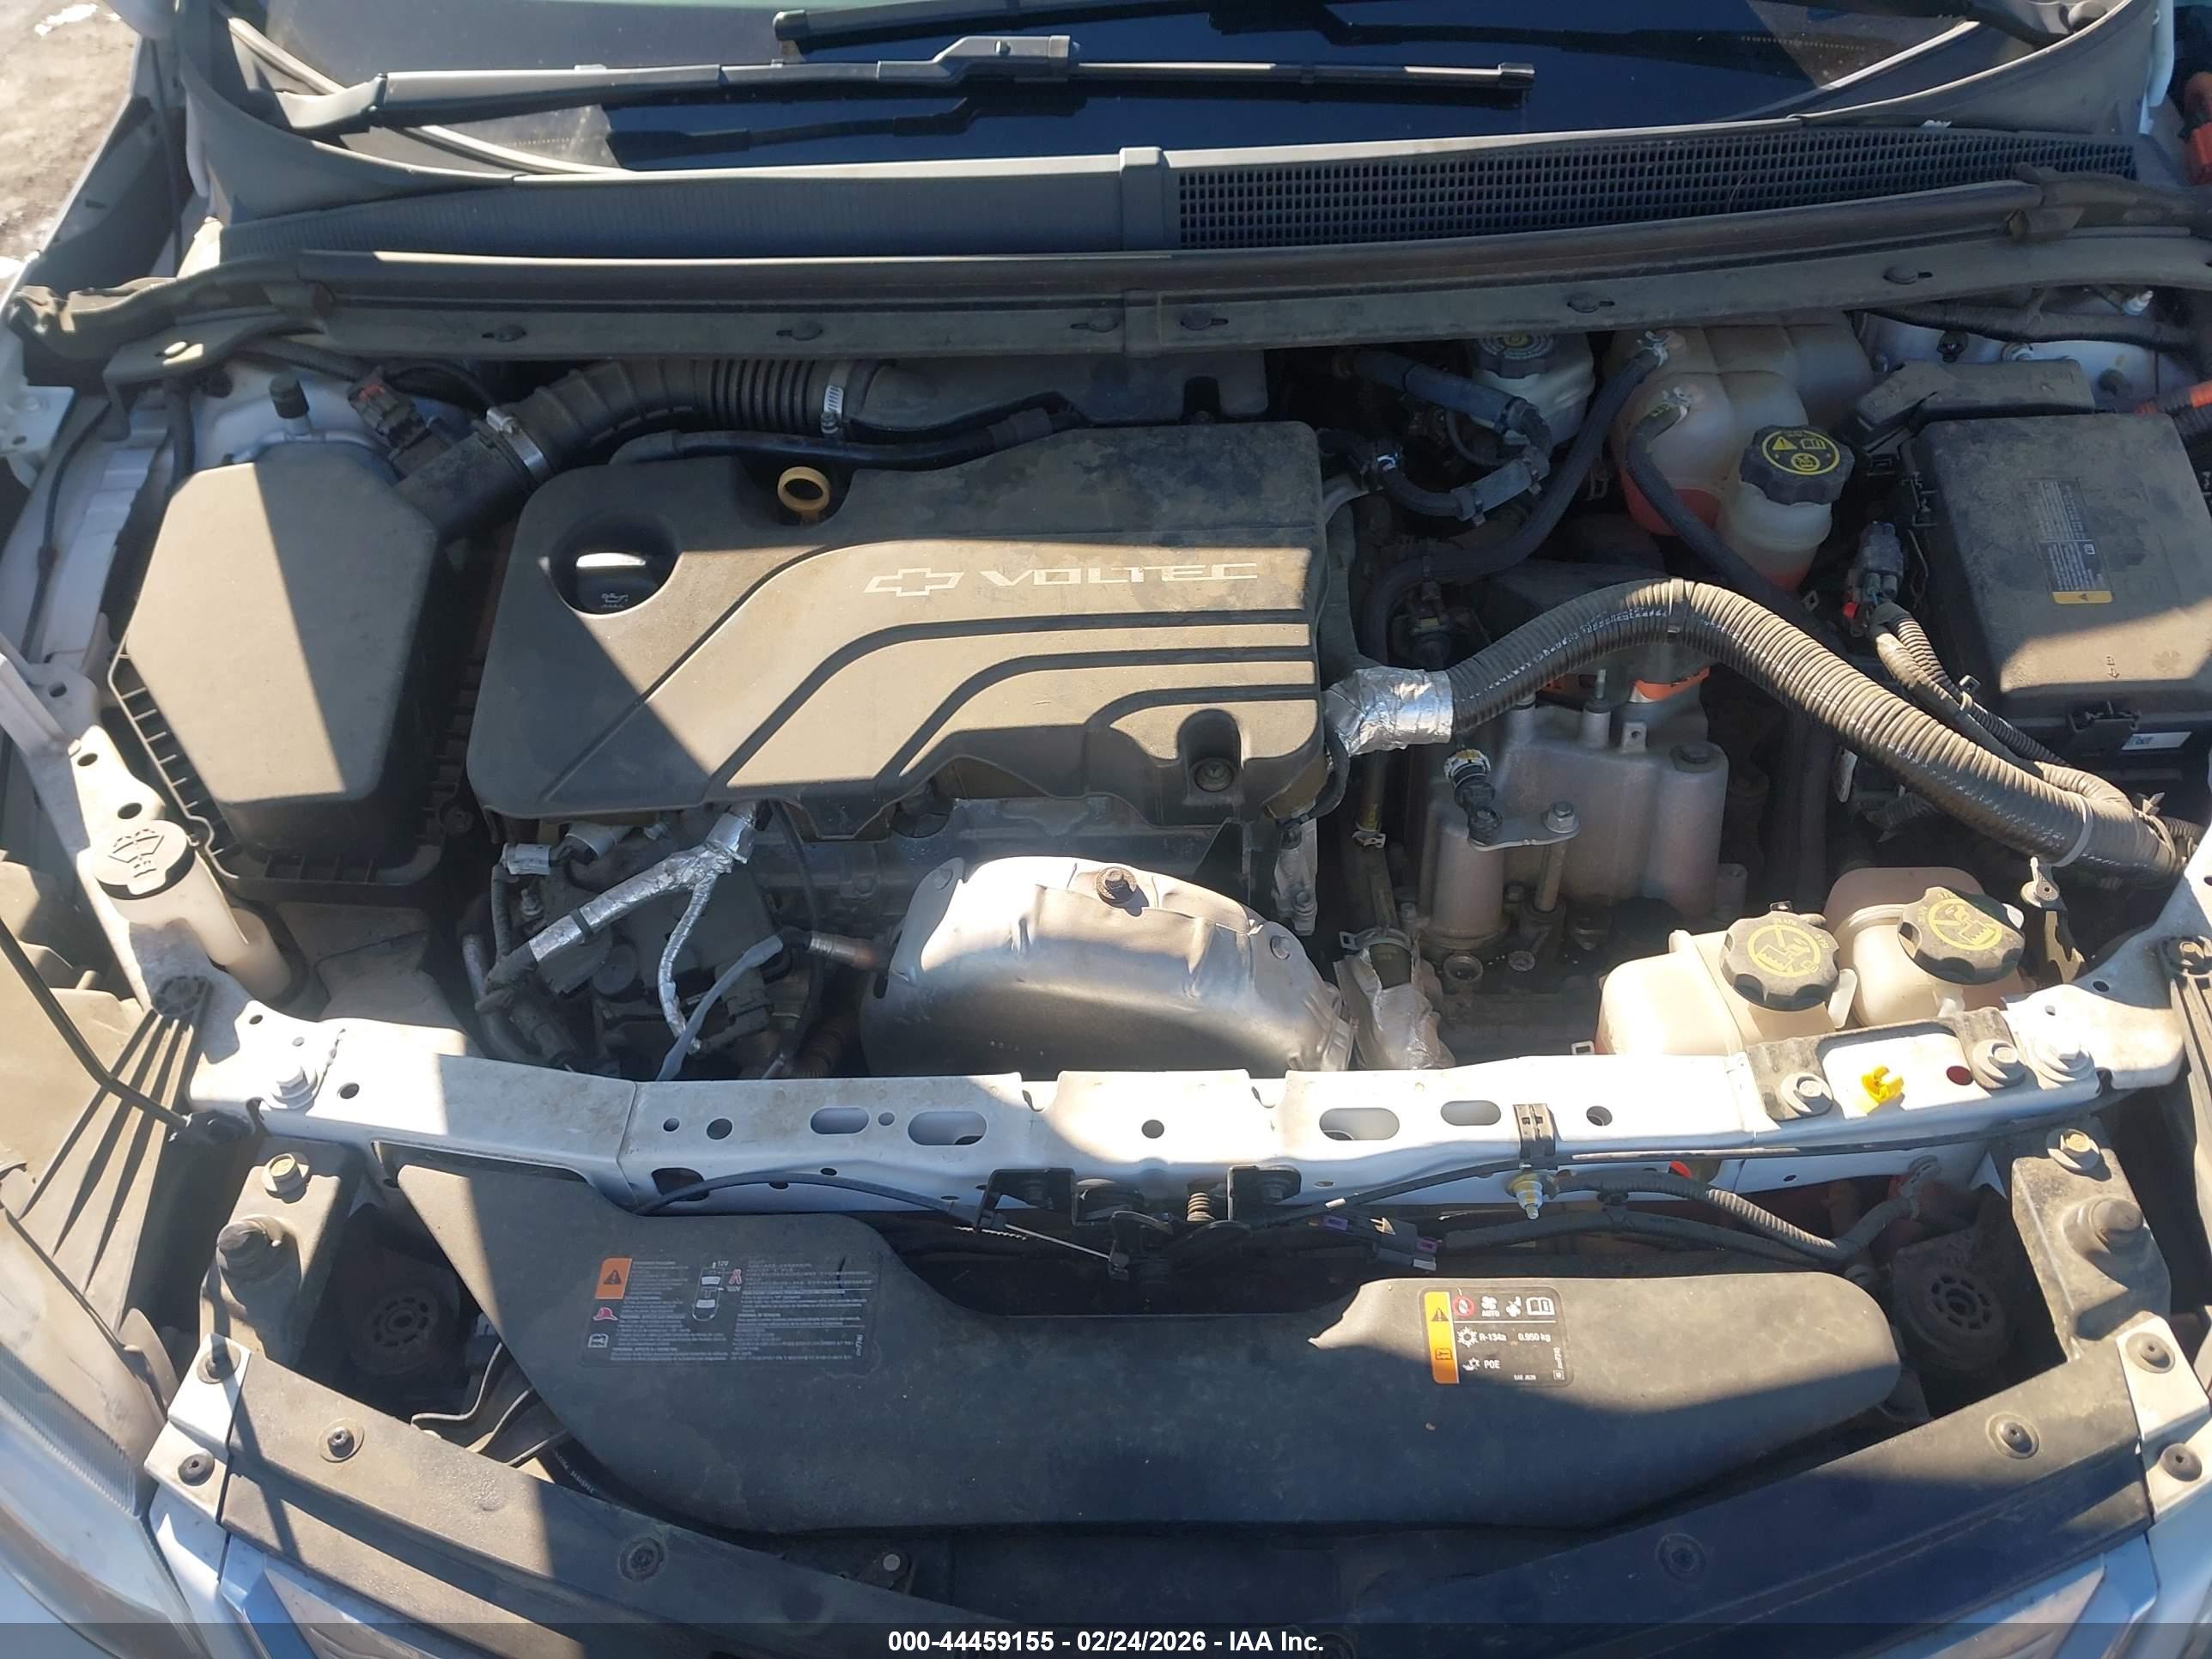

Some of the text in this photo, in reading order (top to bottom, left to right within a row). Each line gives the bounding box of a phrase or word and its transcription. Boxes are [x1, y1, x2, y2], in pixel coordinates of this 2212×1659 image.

[979, 562, 1258, 586] VOLTEC
[1479, 1332, 1507, 1341] R-134a
[1540, 1332, 1552, 1343] kg
[1484, 1359, 1501, 1370] POE
